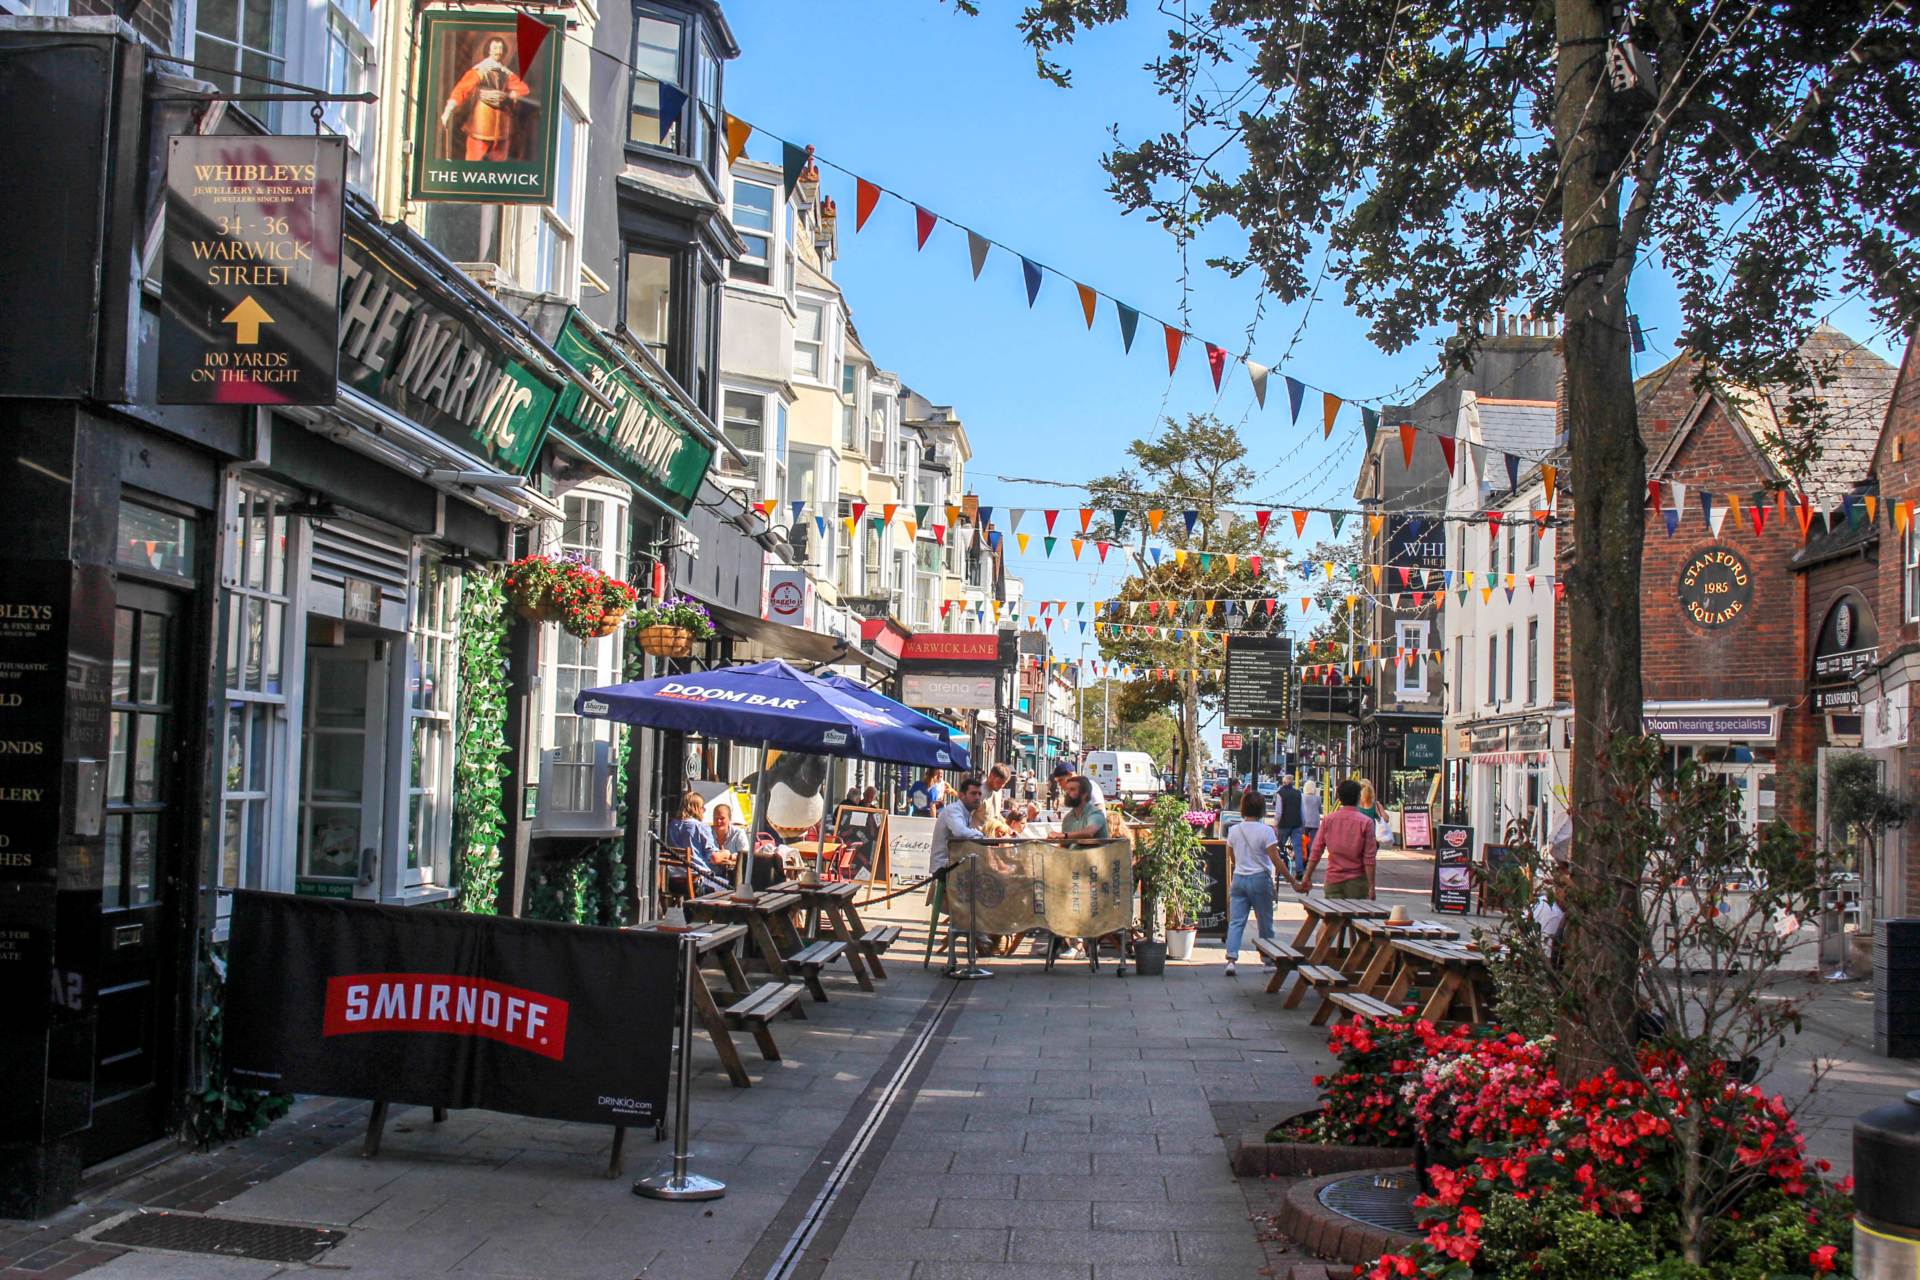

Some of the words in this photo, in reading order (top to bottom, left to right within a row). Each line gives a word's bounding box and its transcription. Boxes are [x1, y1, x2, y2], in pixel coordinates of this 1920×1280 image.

[194, 164, 316, 182] WHIBLEYS
[428, 171, 458, 182] THE
[462, 172, 539, 186] WARWICK
[192, 187, 254, 197] JEWELLERY
[256, 187, 264, 195] &
[267, 187, 293, 195] FINE
[295, 187, 316, 196] ART
[216, 216, 242, 236] 34
[263, 216, 289, 236] 36
[192, 241, 312, 261] WARWICK
[208, 266, 293, 286] STREET
[204, 352, 229, 367] 100
[233, 352, 288, 367] YARDS
[191, 369, 215, 383] ON
[220, 369, 249, 382] THE
[253, 369, 300, 383] RIGHT
[1684, 552, 1747, 586] STANFORD
[1704, 582, 1728, 593] 1985
[1688, 600, 1743, 624] SQUARE
[34, 623, 51, 631] ART
[906, 643, 960, 654] WARWICK
[963, 644, 994, 654] LANE
[929, 682, 969, 693] arena
[660, 683, 748, 702] DOOM
[745, 695, 802, 709] BAR
[1825, 692, 1850, 705] STANFORD
[1648, 719, 1678, 730] bloom
[1679, 719, 1713, 732] hearing
[1715, 719, 1767, 732] specialists
[345, 983, 548, 1039] SMIRNOFF
